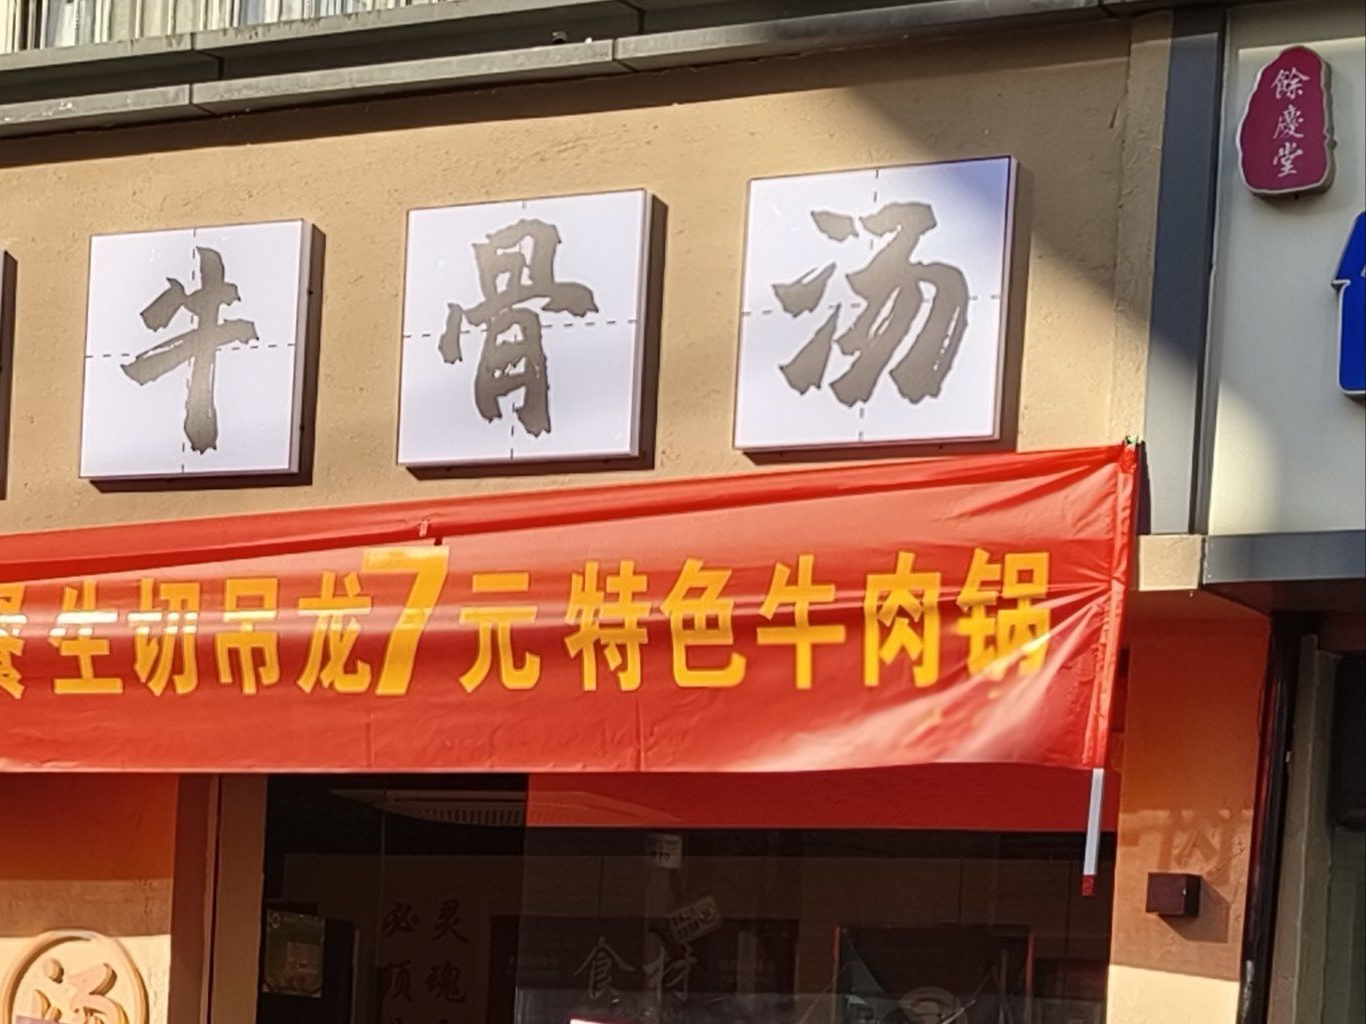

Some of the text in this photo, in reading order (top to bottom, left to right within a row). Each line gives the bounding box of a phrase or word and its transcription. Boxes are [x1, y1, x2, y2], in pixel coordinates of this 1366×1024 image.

[1270, 67, 1311, 178] 餘慶堂
[47, 545, 541, 697] 生切吊龙7元
[564, 547, 1053, 693] 特色牛肉锅
